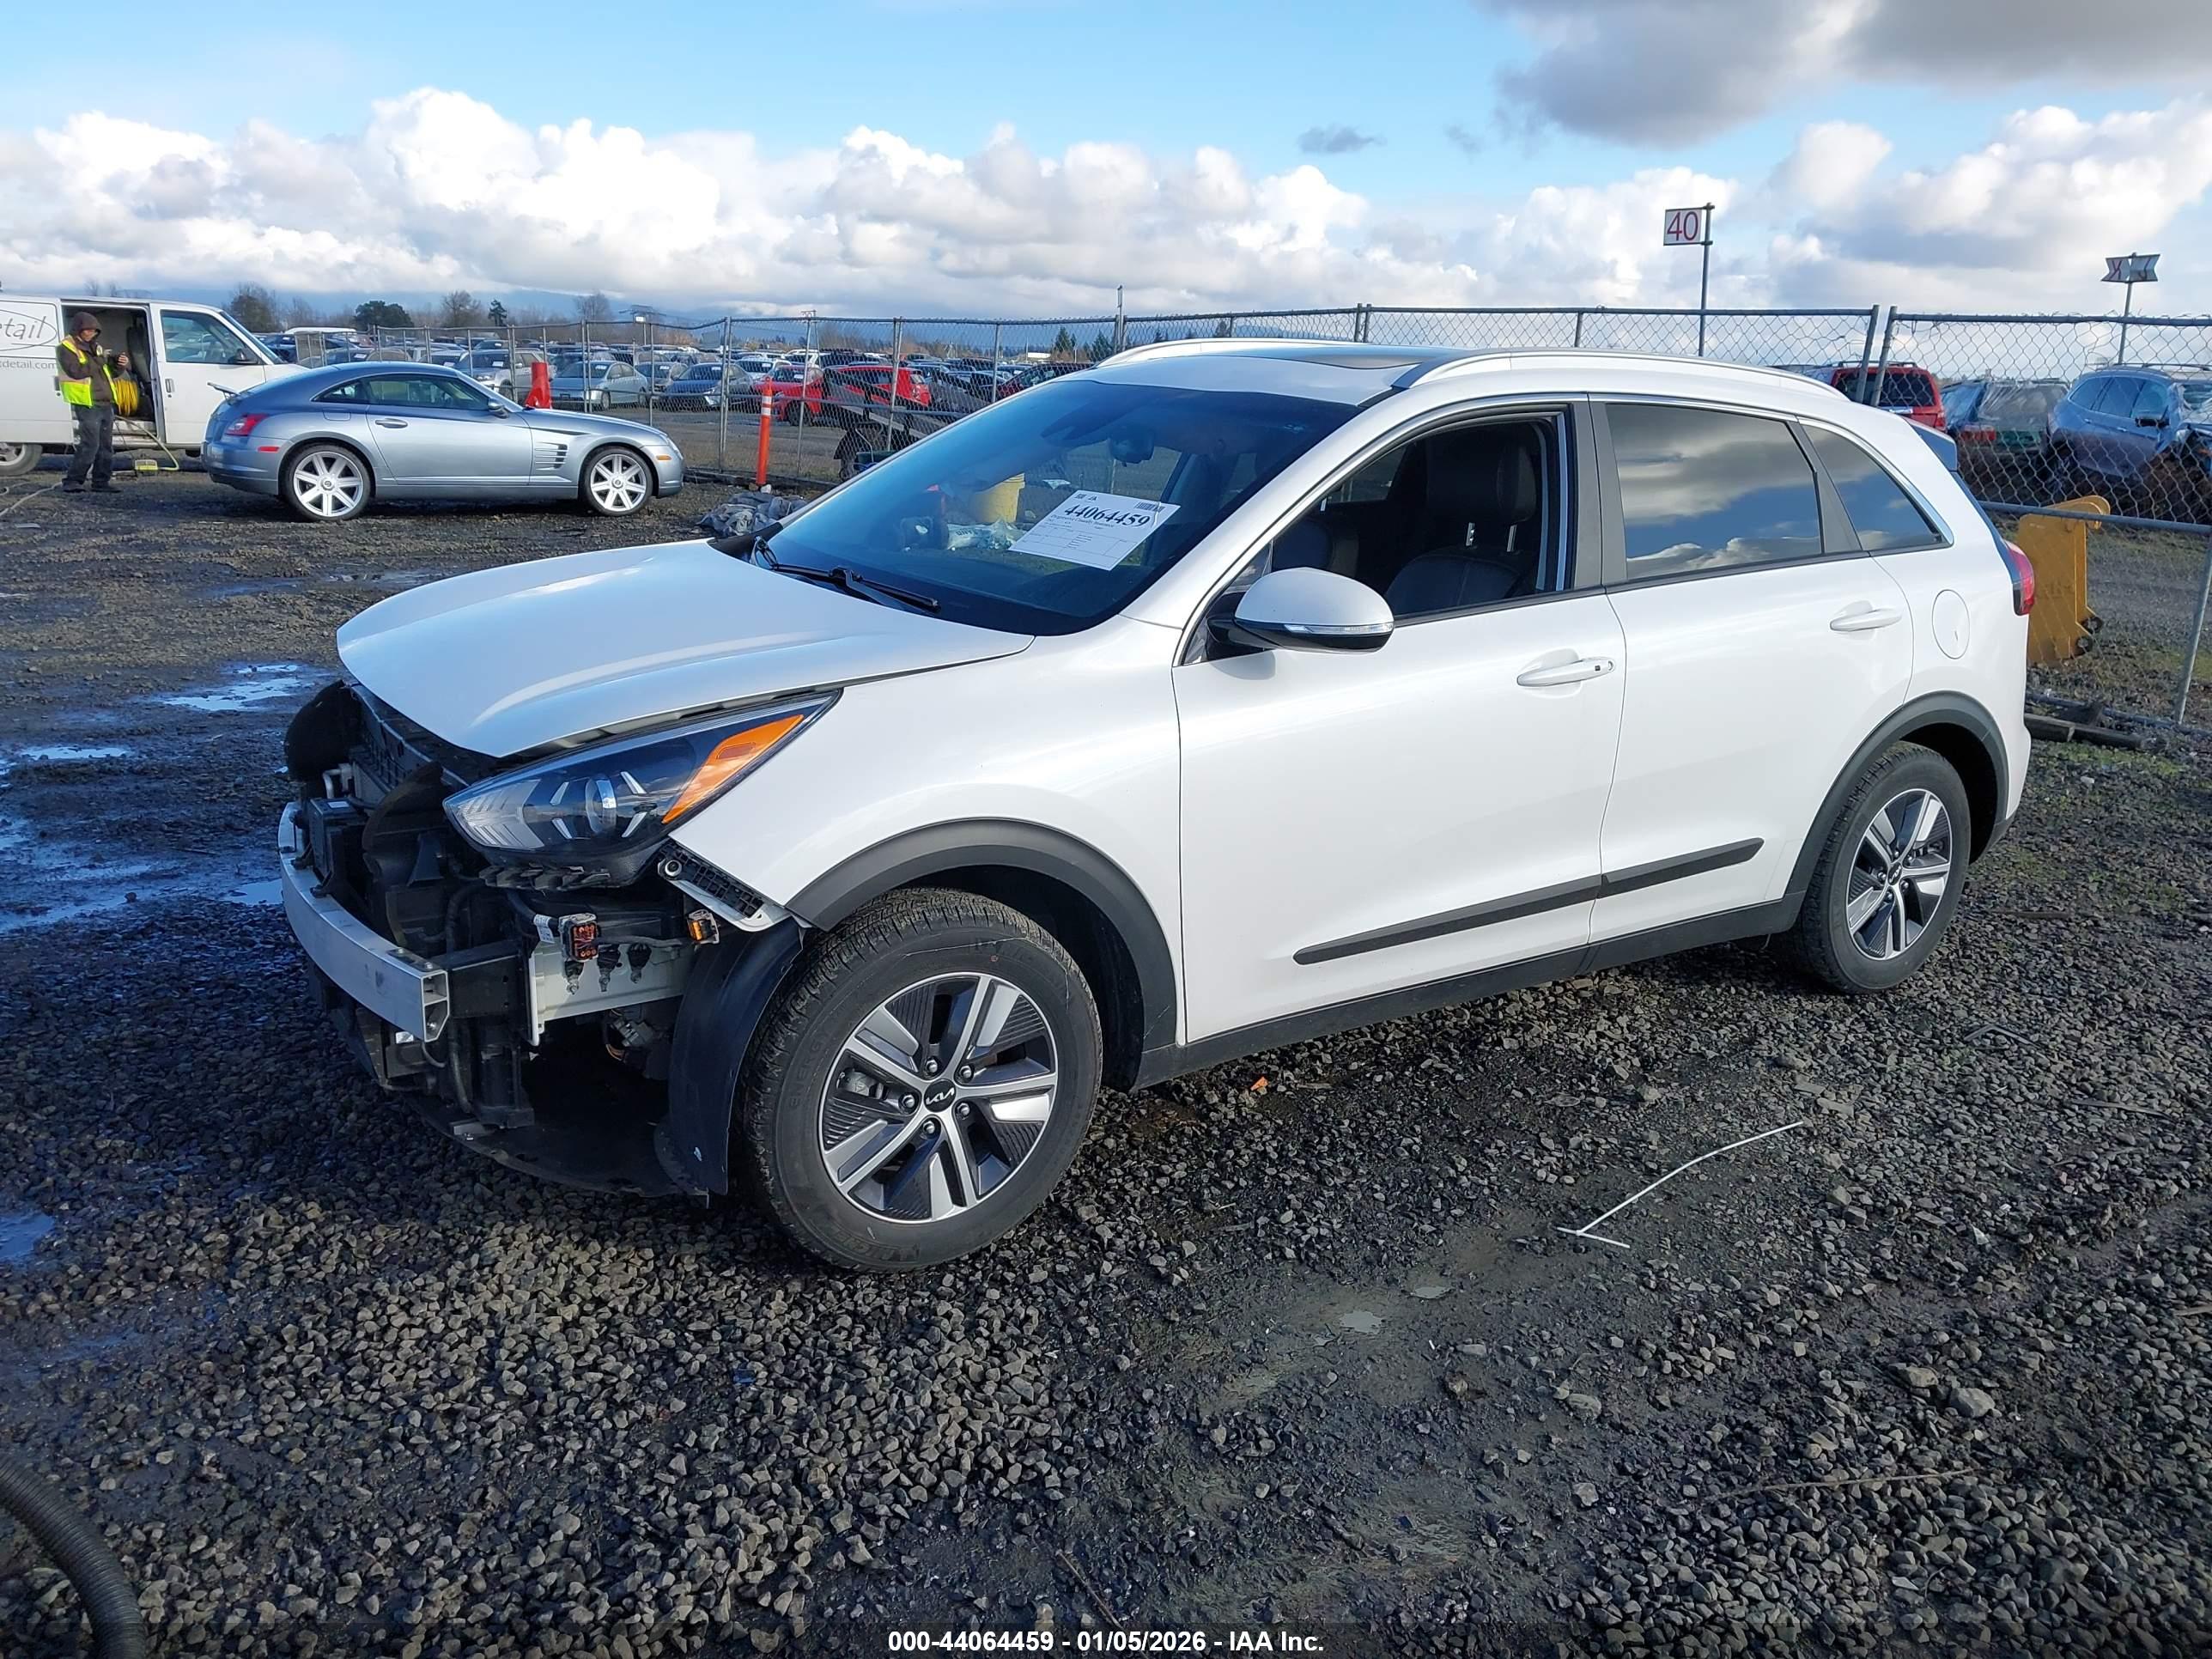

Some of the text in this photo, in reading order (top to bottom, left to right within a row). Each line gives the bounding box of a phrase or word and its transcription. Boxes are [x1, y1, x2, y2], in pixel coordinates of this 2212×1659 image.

[1667, 211, 1698, 241] 40
[0, 316, 46, 340] tail
[1065, 504, 1151, 527] 44064459
